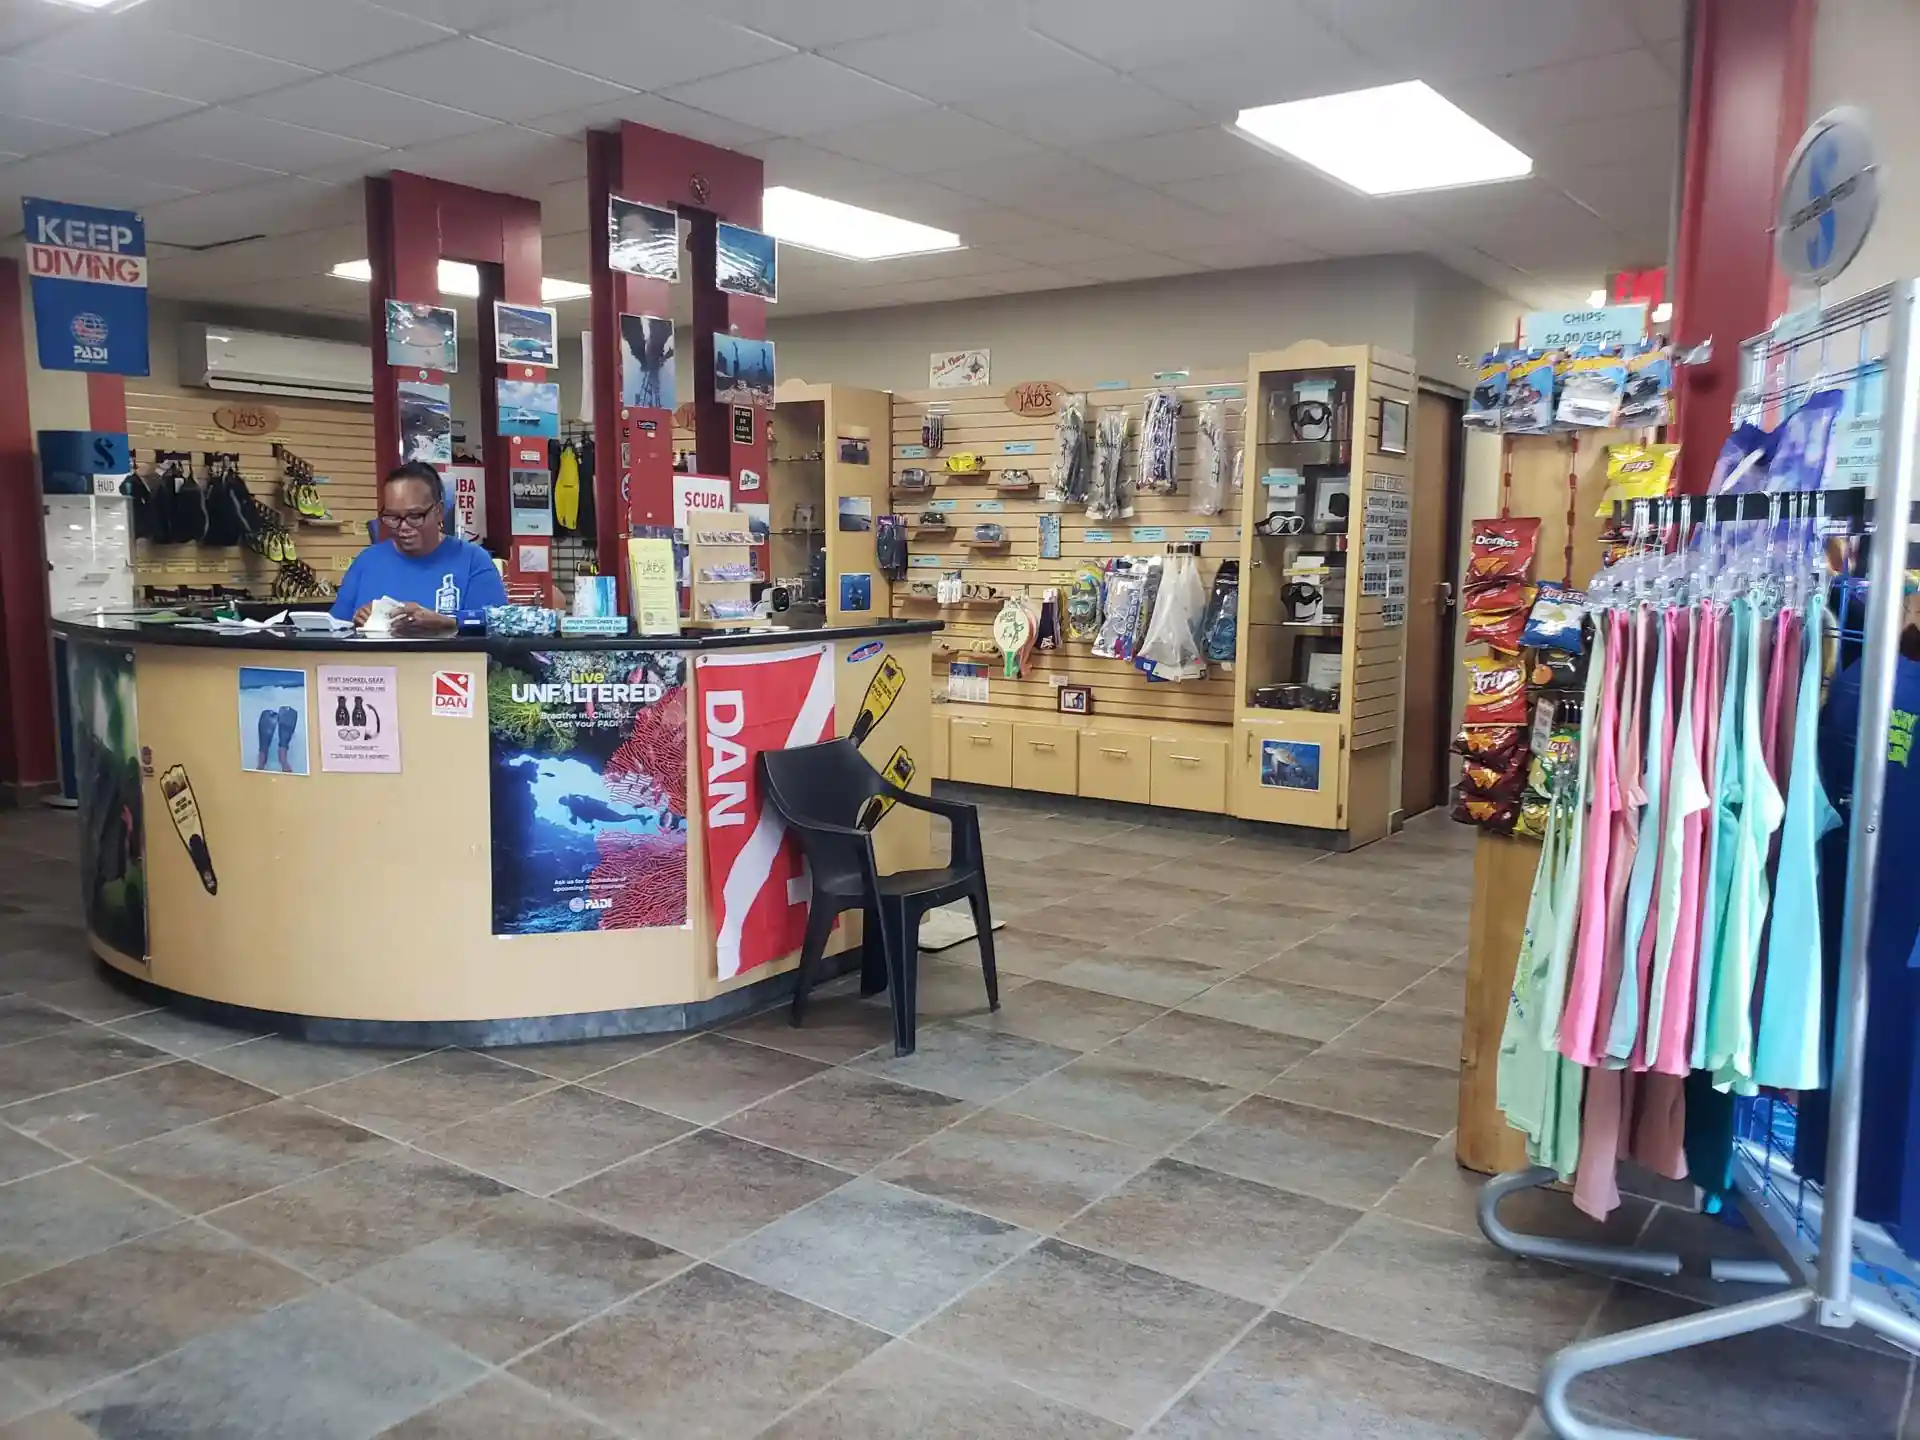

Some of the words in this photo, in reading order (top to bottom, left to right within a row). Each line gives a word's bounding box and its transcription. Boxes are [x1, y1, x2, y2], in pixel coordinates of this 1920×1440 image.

[36, 216, 134, 252] KEEP
[32, 247, 140, 283] DIVING
[1562, 311, 1606, 324] CHIPS:
[72, 345, 109, 359] PADI
[1019, 392, 1053, 412] JADS
[524, 484, 549, 497] PADI
[684, 491, 725, 509] SCUBA
[1475, 535, 1520, 549] Doritos
[571, 671, 605, 684] Live
[435, 696, 468, 709] DAN
[540, 711, 577, 720] Breathe
[592, 711, 612, 720] Chill
[556, 720, 573, 728] Get
[575, 720, 595, 728] Your
[705, 690, 748, 829] DAN
[584, 898, 613, 910] PADI
